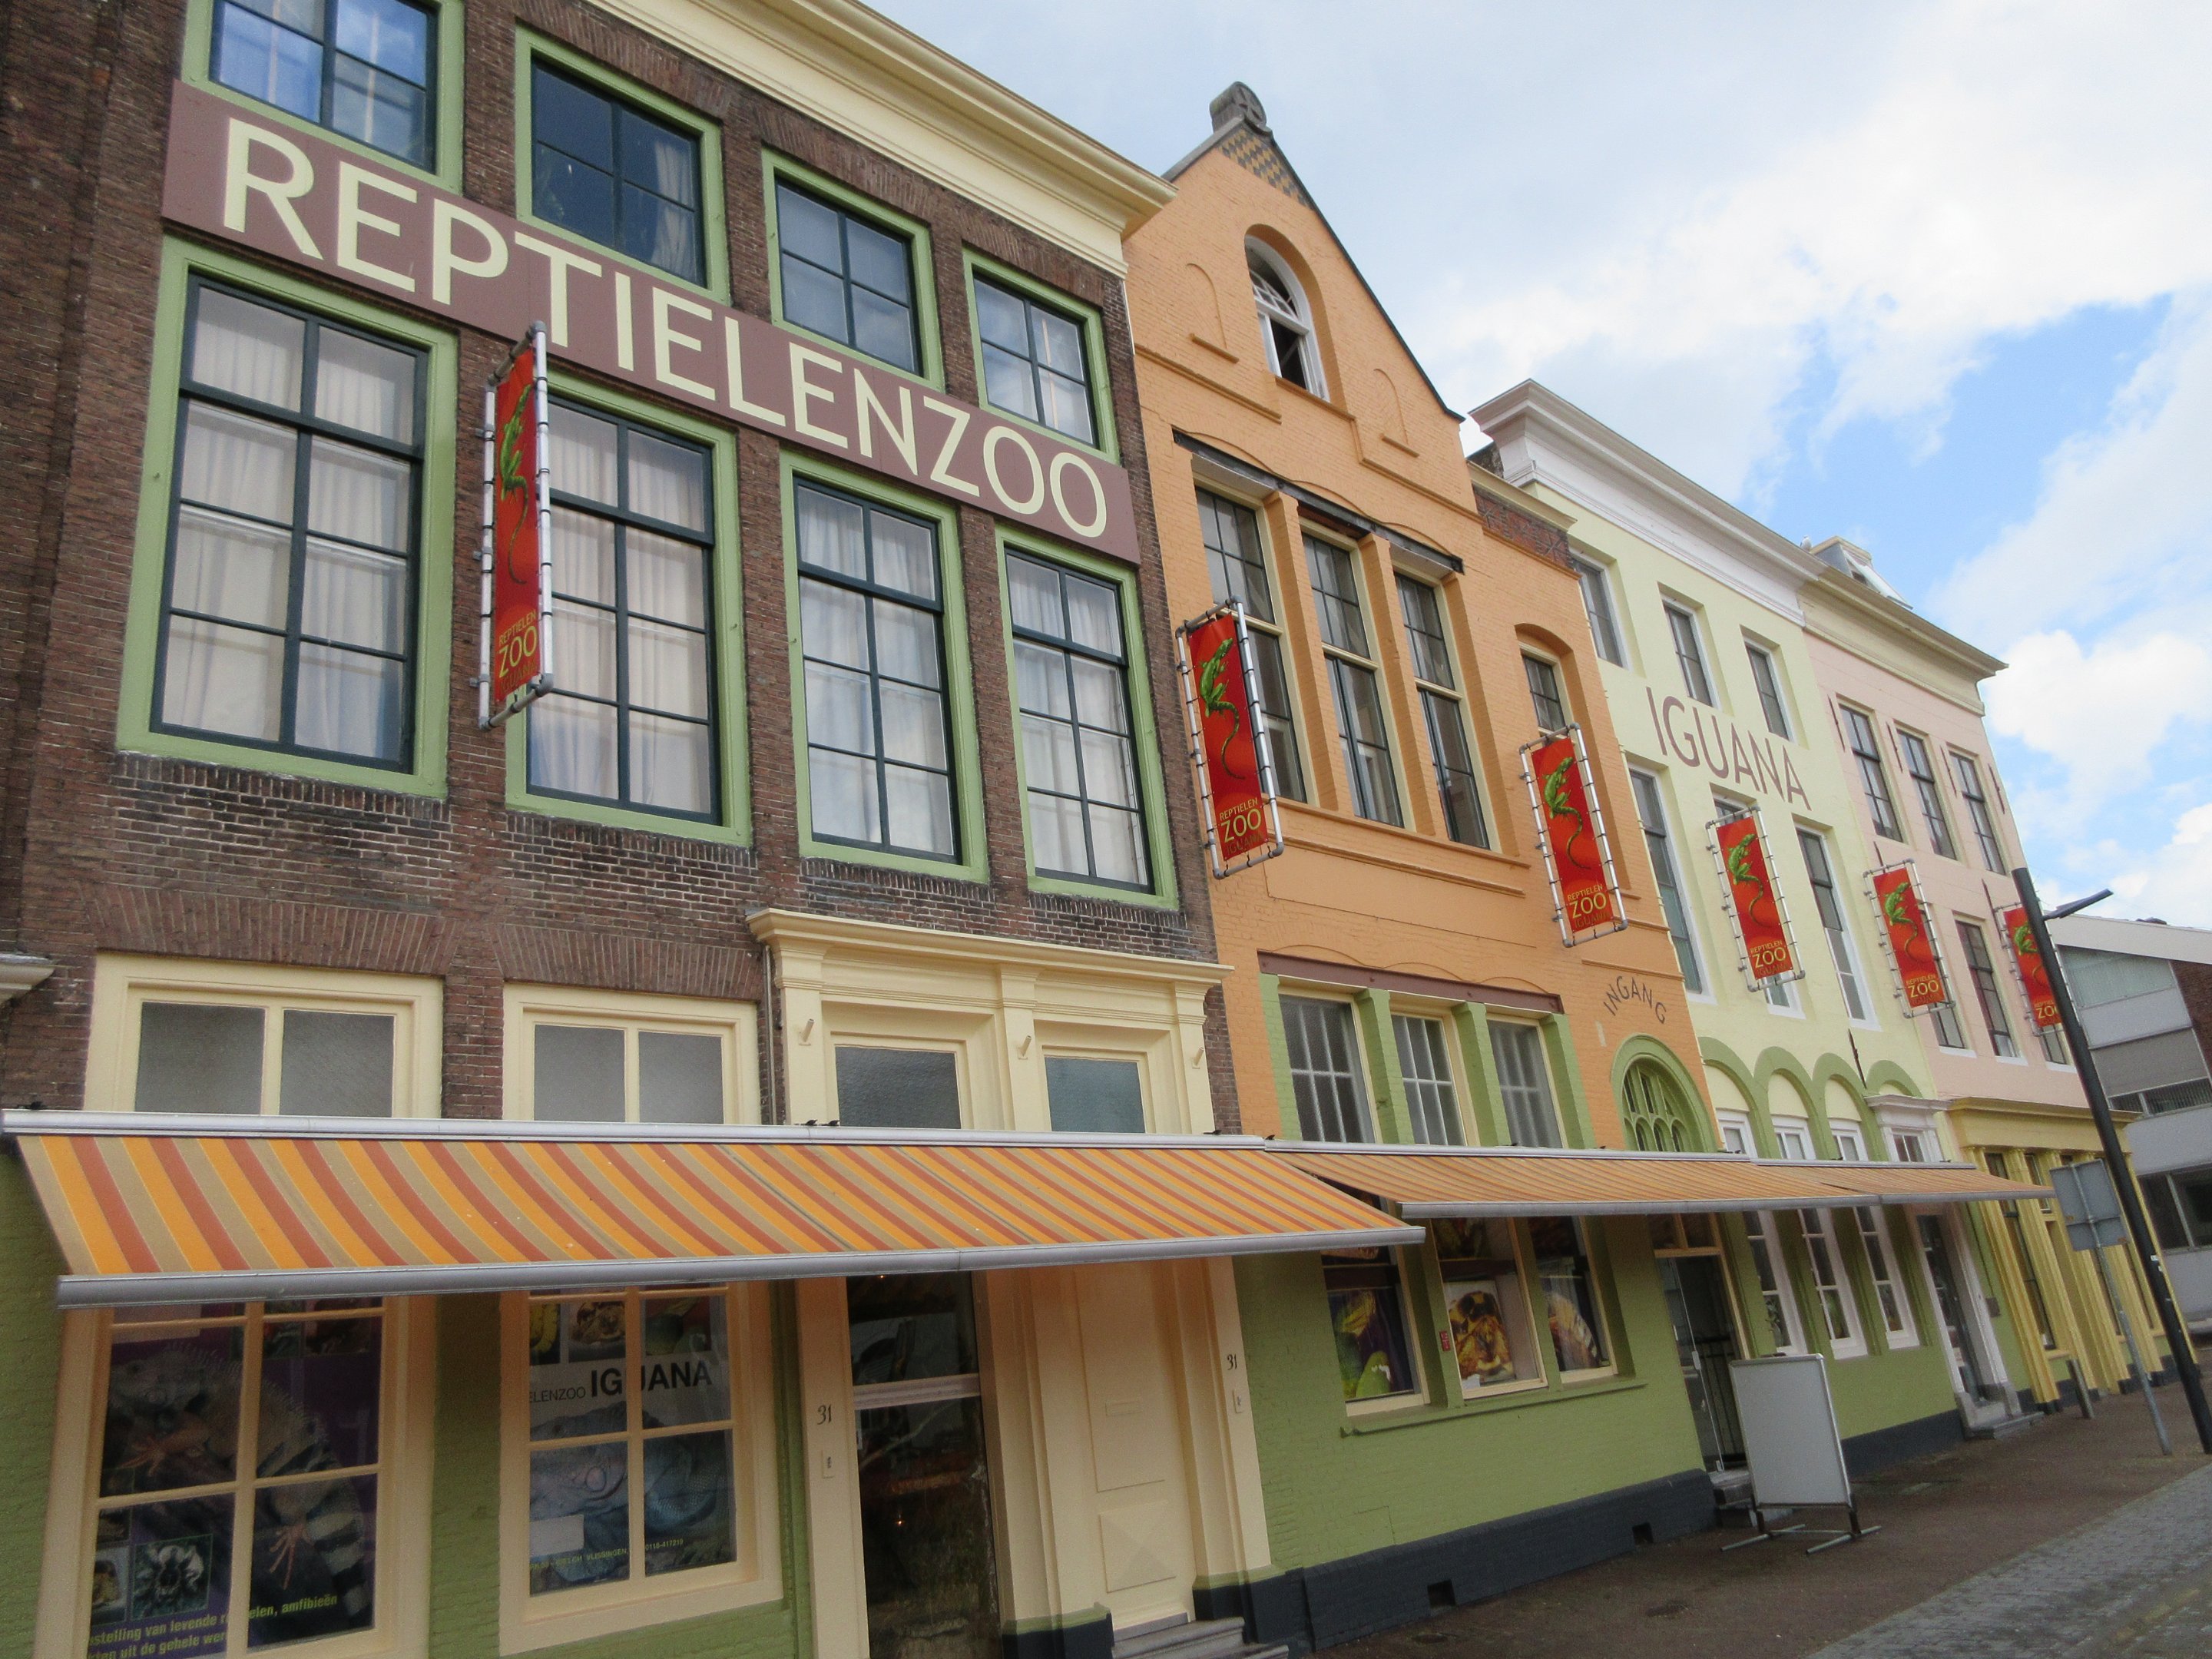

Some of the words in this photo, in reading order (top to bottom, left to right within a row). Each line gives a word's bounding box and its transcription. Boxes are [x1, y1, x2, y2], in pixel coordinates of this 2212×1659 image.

[223, 118, 1108, 538] REPTIELENZOO
[498, 609, 536, 646] REPTIELEN
[498, 625, 537, 678] ZOO
[1646, 686, 1813, 811] IGUANA
[1220, 796, 1258, 821] REPTIELEN
[1220, 808, 1262, 843] ZOO
[1567, 883, 1603, 901] REPTIELEN
[1569, 892, 1607, 919] ZOO
[1750, 939, 1783, 953] REPTIELEN
[1752, 947, 1786, 968] ZOO
[1603, 975, 1667, 1025] INGANG
[1907, 979, 1939, 998] ZOO
[1227, 1353, 1237, 1371] 31
[816, 1404, 832, 1426] 31
[145, 1623, 167, 1637] van
[171, 1614, 217, 1633] levende
[281, 1593, 338, 1614] amfibieën
[120, 1644, 137, 1658] uit
[140, 1642, 156, 1654] de
[159, 1634, 200, 1655] gehele
